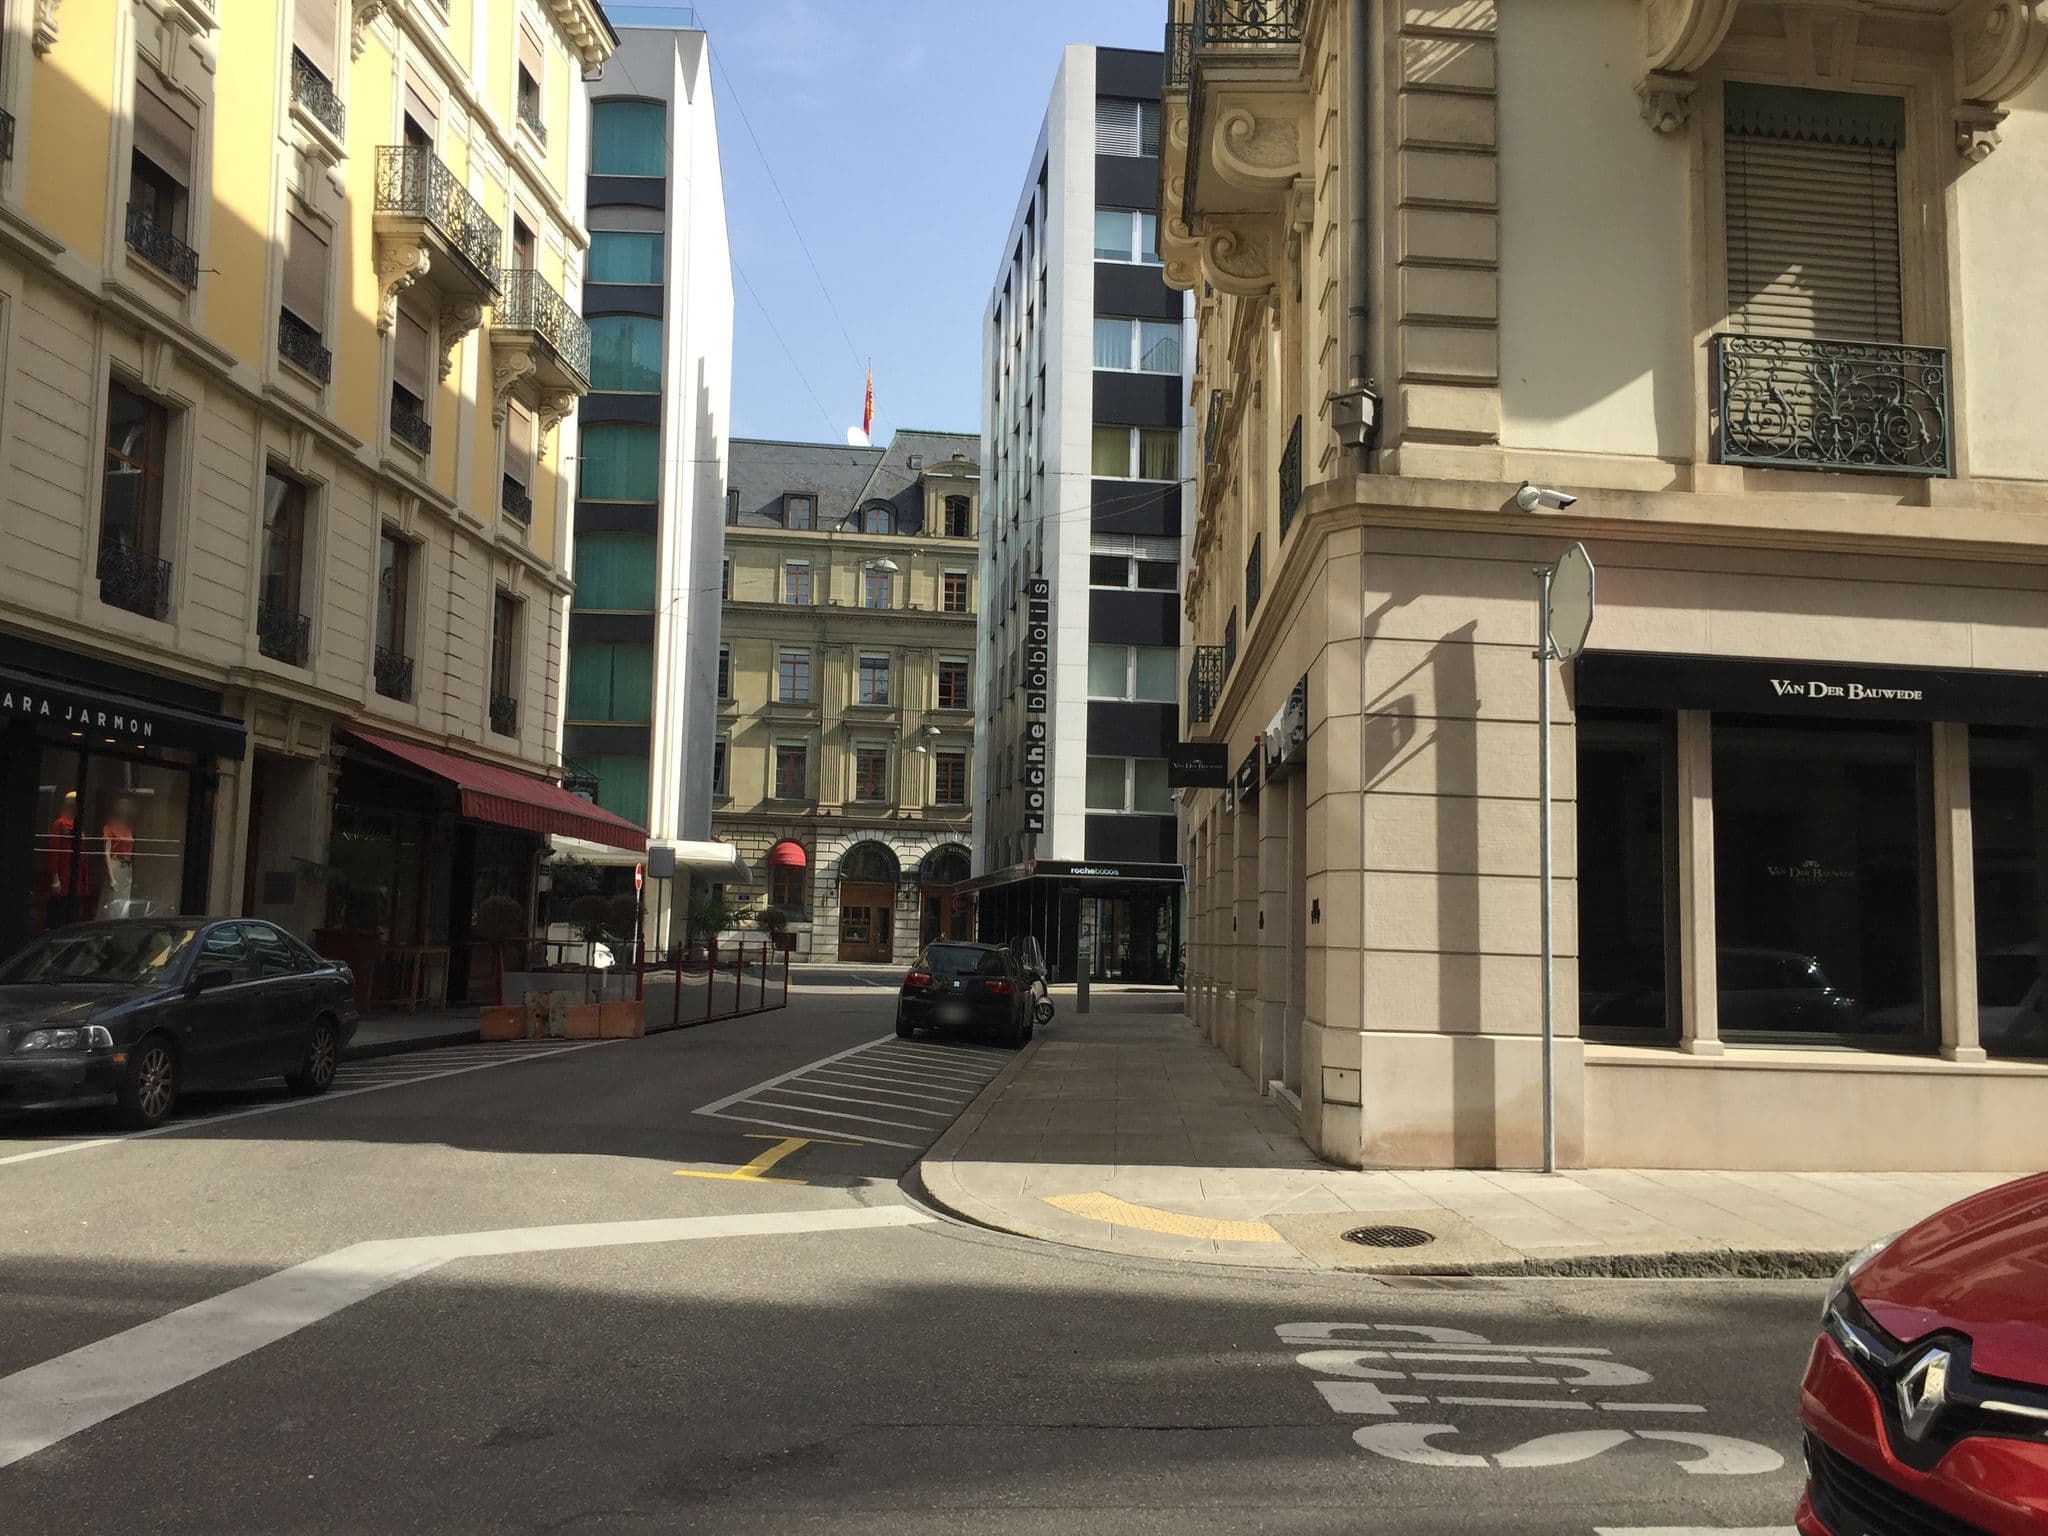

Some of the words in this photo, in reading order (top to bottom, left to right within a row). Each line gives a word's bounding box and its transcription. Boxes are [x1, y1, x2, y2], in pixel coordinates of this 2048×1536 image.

[1029, 582, 1048, 710] bobois
[65, 706, 152, 737] JARMON
[1770, 679, 1805, 696] VAN
[1808, 681, 1845, 698] DER
[1848, 683, 1923, 701] BAUWEDE
[1027, 723, 1045, 831] roche
[1082, 925, 1090, 935] P
[1273, 1321, 1786, 1476] STOP
